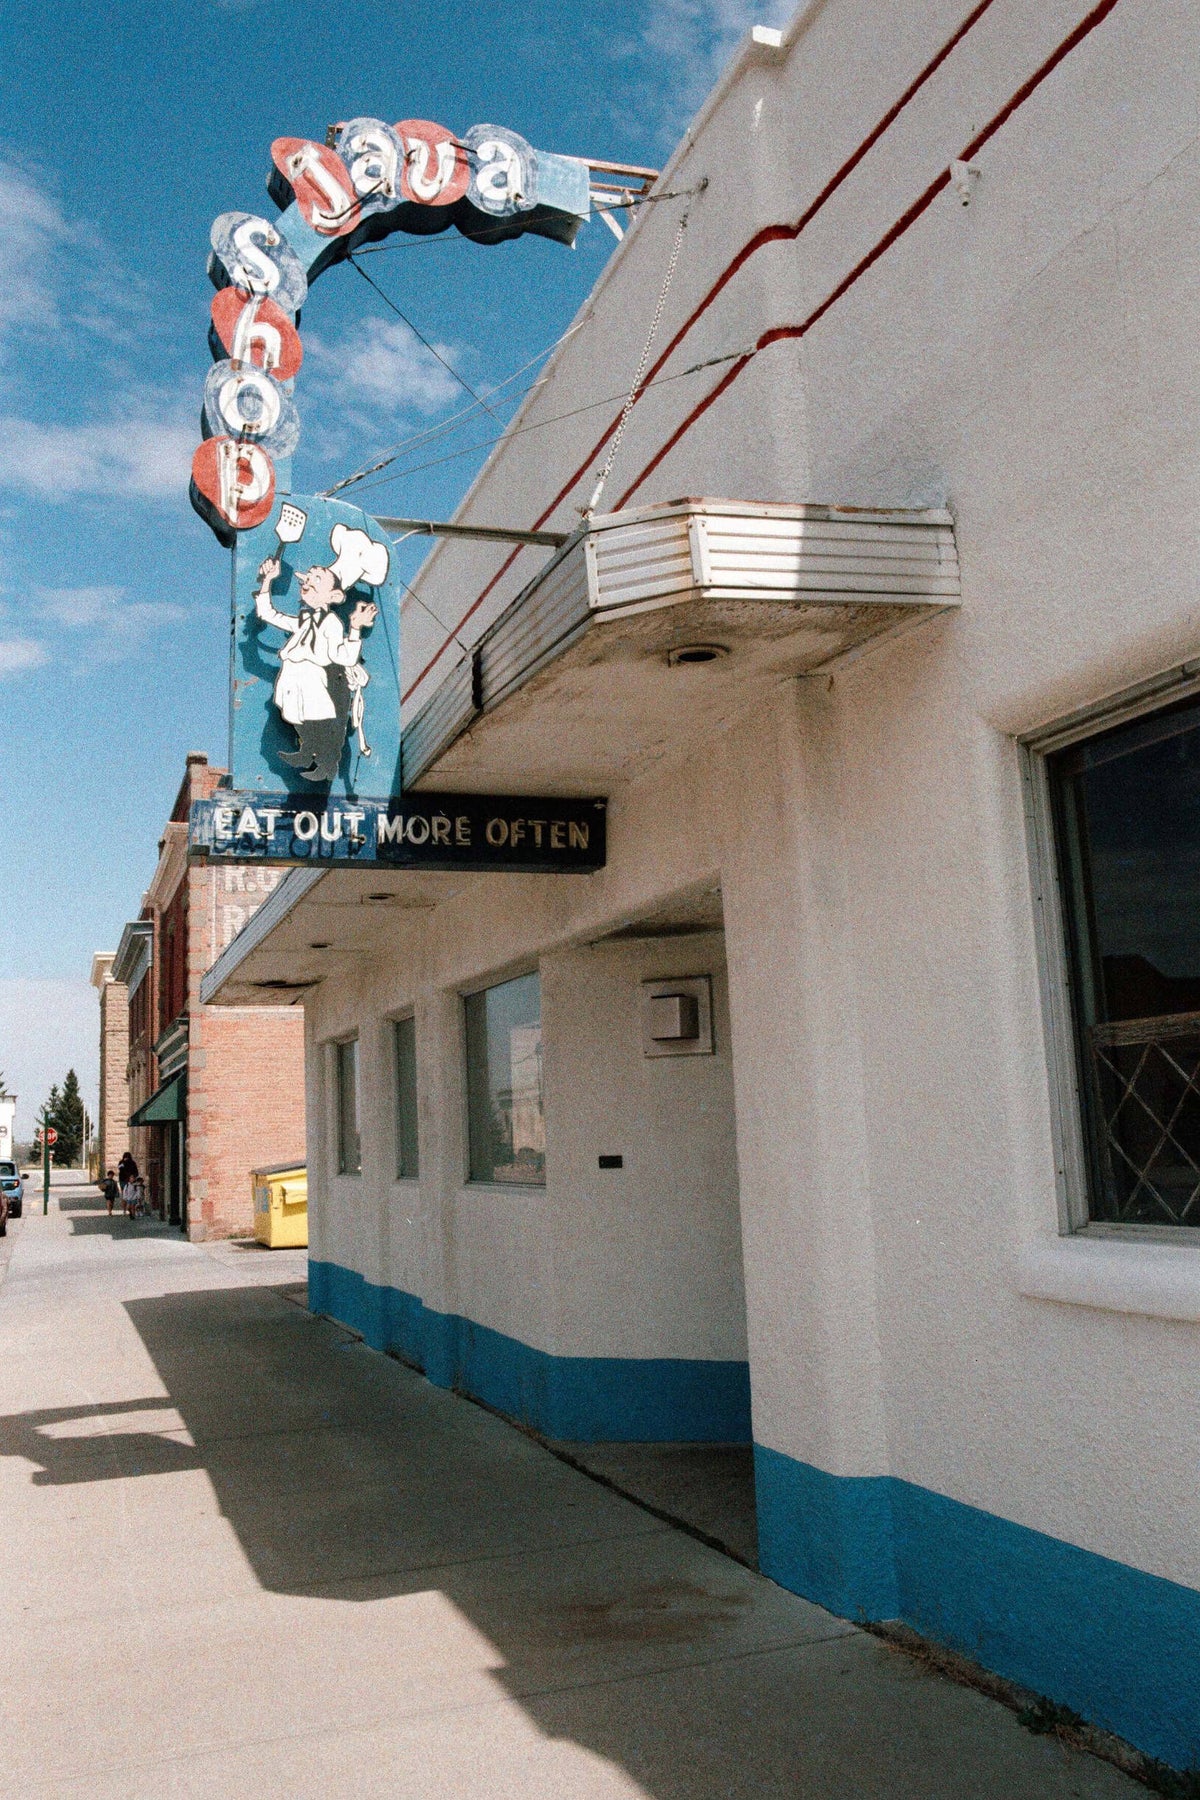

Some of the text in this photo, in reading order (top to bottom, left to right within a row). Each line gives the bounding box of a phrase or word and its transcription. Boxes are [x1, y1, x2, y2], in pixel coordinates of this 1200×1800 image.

[213, 806, 590, 849] EAT OUT MORE OFTEN
